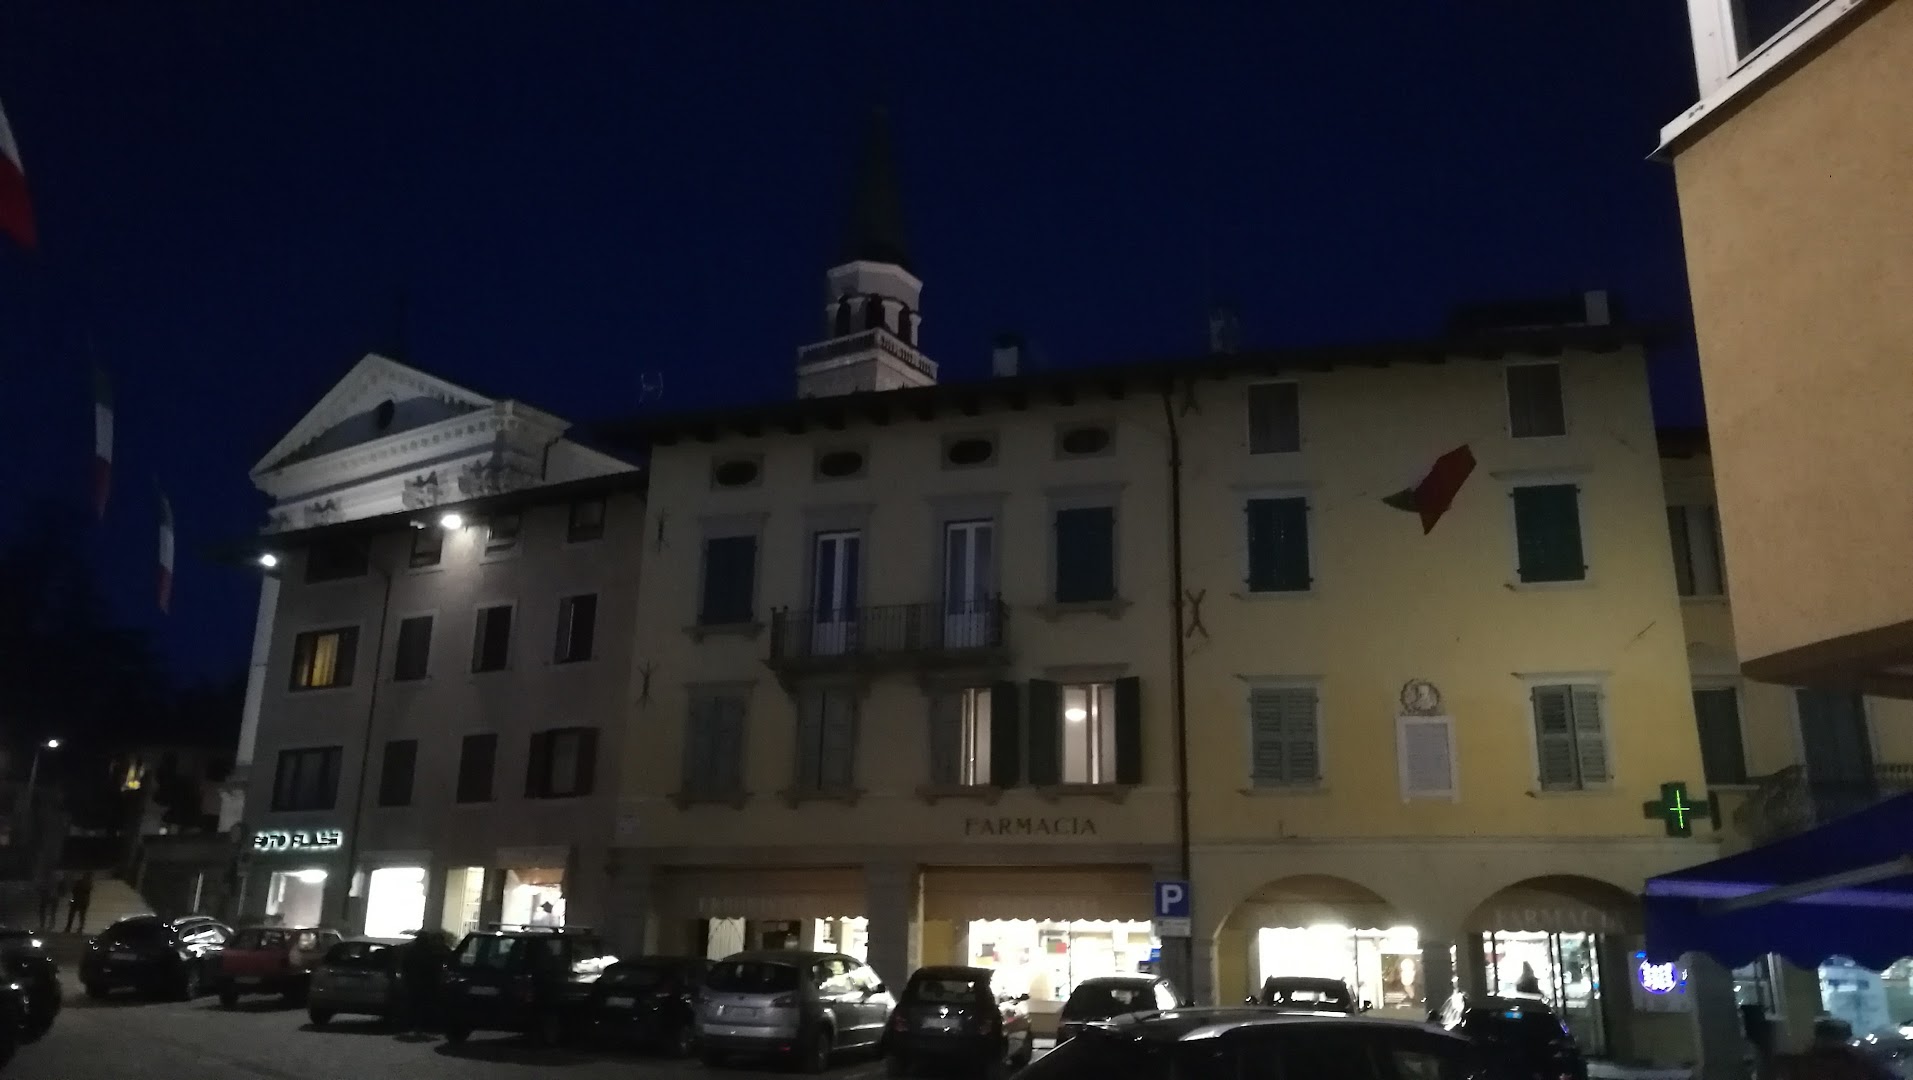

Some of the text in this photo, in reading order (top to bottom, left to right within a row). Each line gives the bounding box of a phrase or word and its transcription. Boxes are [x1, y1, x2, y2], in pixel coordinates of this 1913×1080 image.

[965, 817, 1098, 835] FARMACIA
[253, 831, 289, 850] FOTO
[1161, 885, 1183, 914] P
